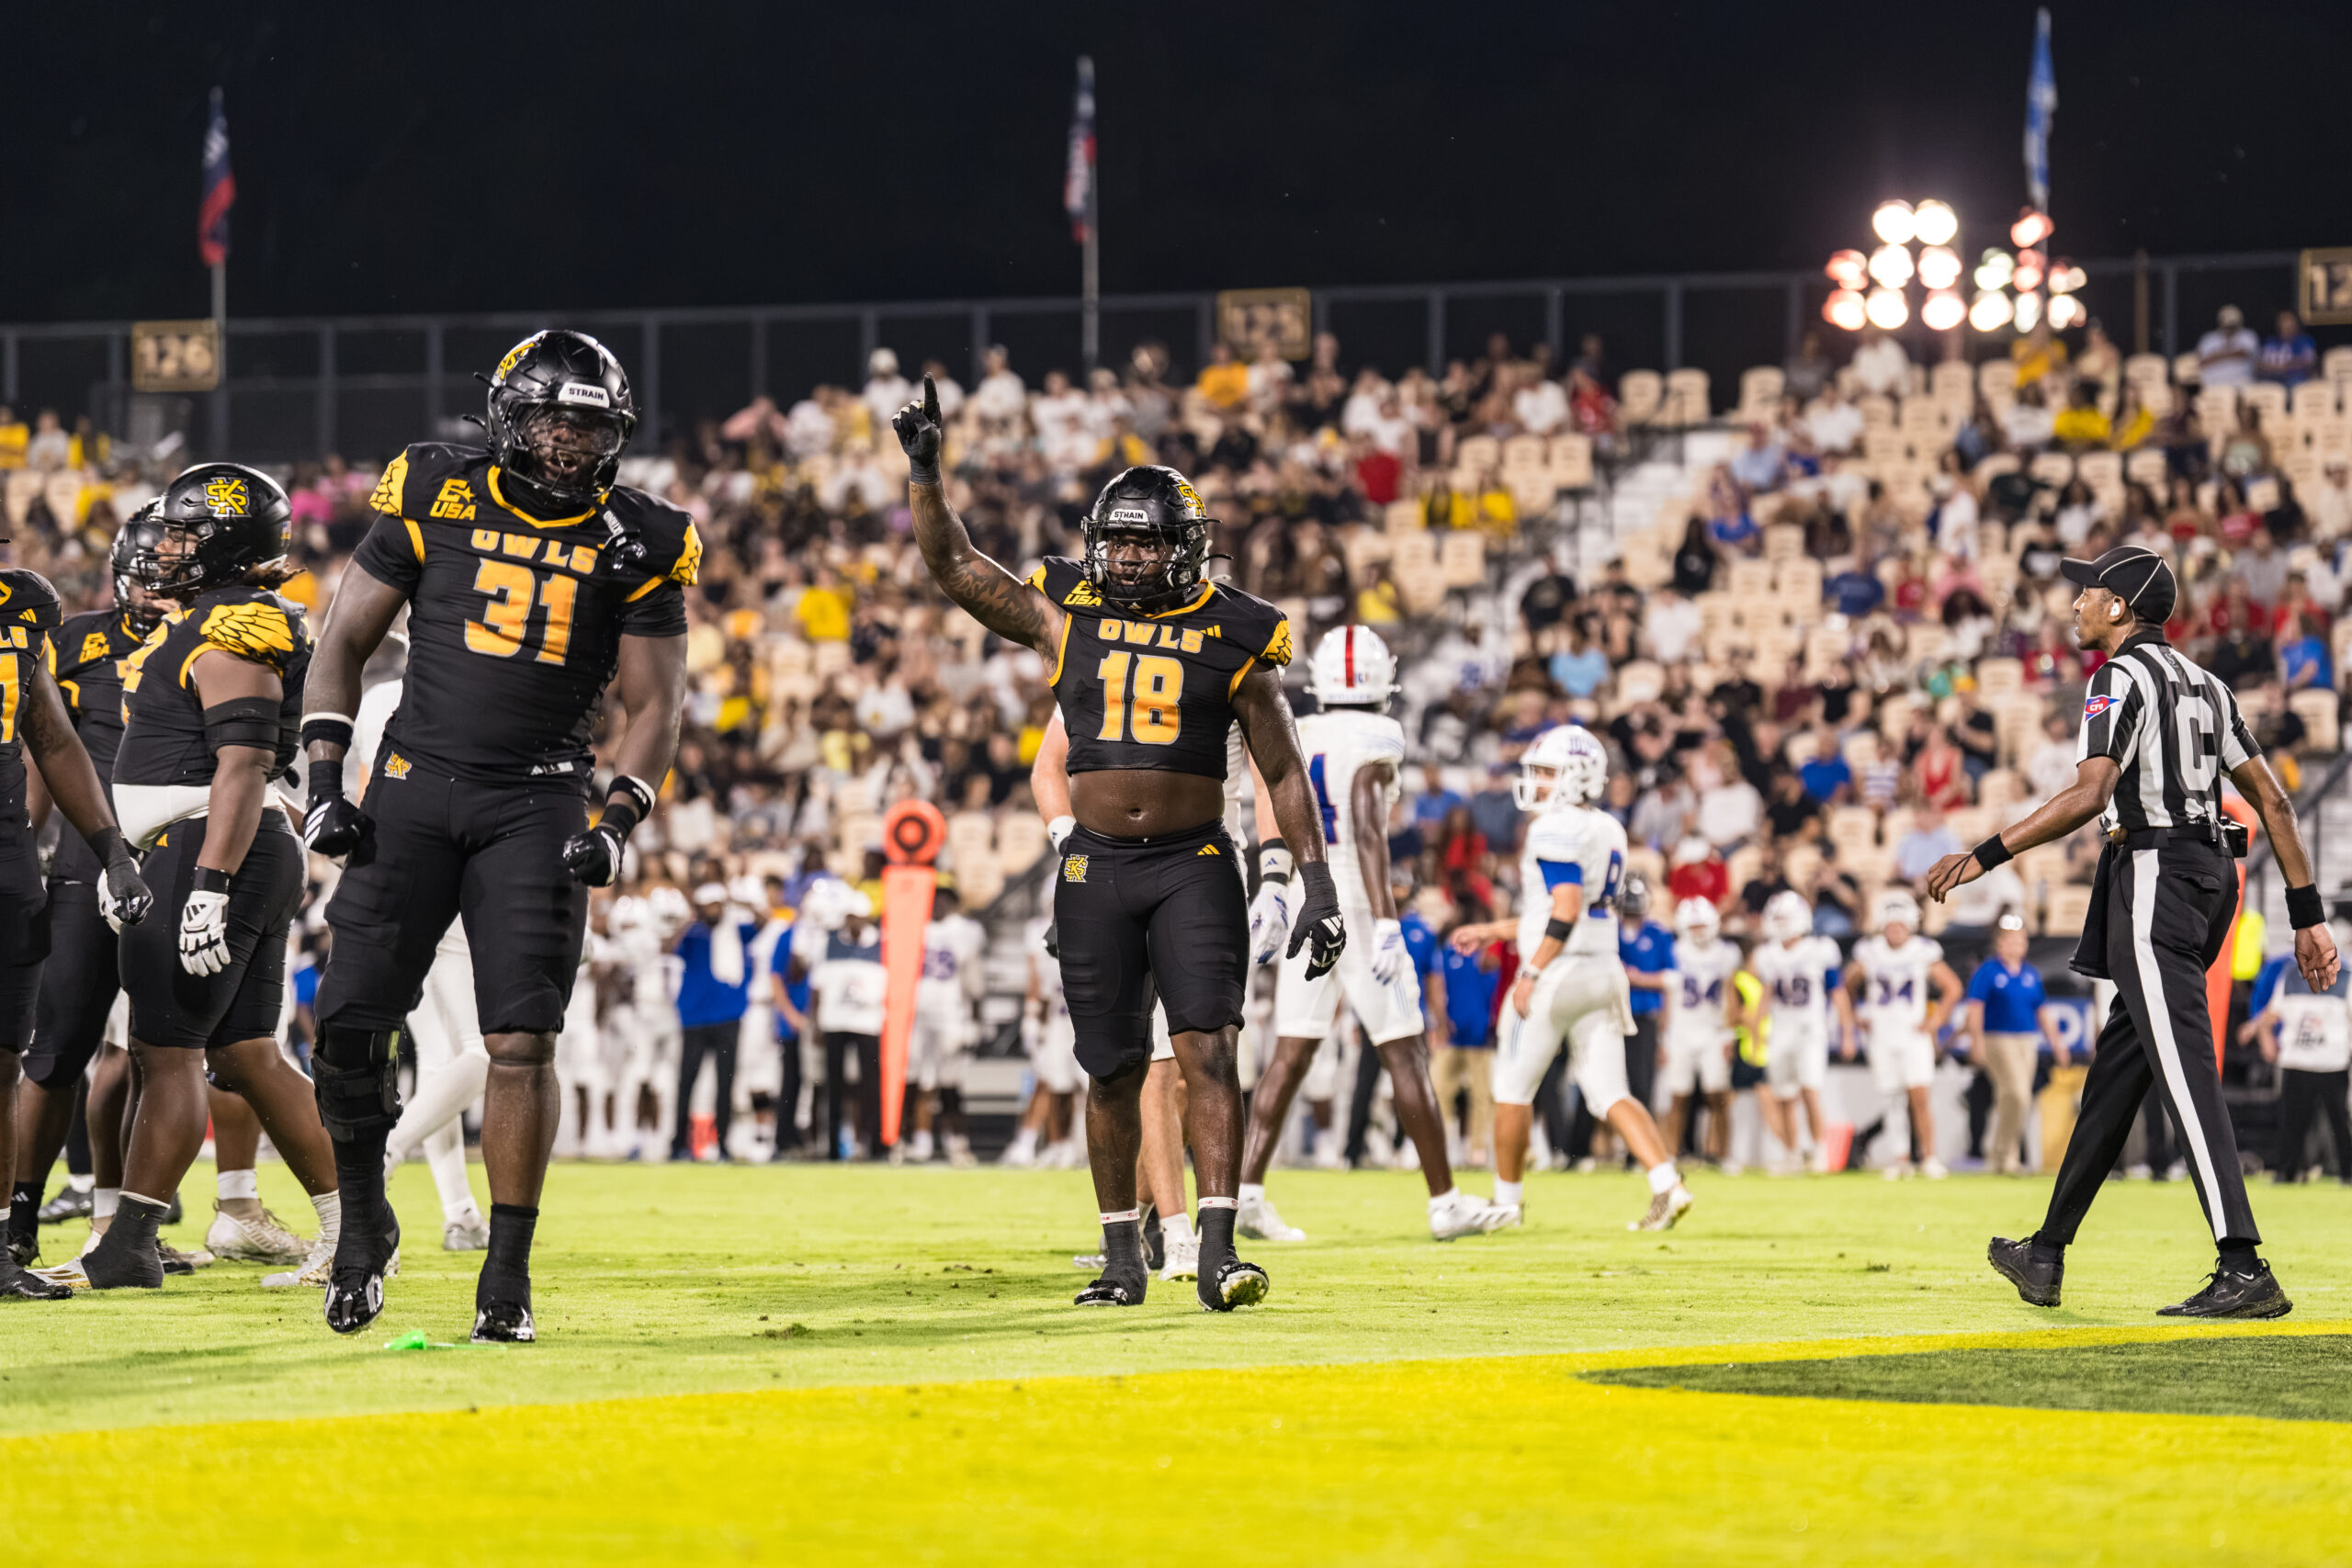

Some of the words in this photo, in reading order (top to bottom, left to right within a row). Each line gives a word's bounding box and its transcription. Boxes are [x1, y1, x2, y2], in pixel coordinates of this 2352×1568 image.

[138, 335, 213, 377] 126
[569, 387, 605, 400] STRAIN
[429, 501, 477, 521] USA
[1114, 511, 1144, 520] STRAIN
[470, 528, 597, 575] OWLS
[464, 558, 579, 666] 31
[1063, 593, 1102, 607] USA
[1098, 618, 1204, 653] OWLS
[1096, 649, 1184, 745] 18
[2175, 694, 2217, 792] C
